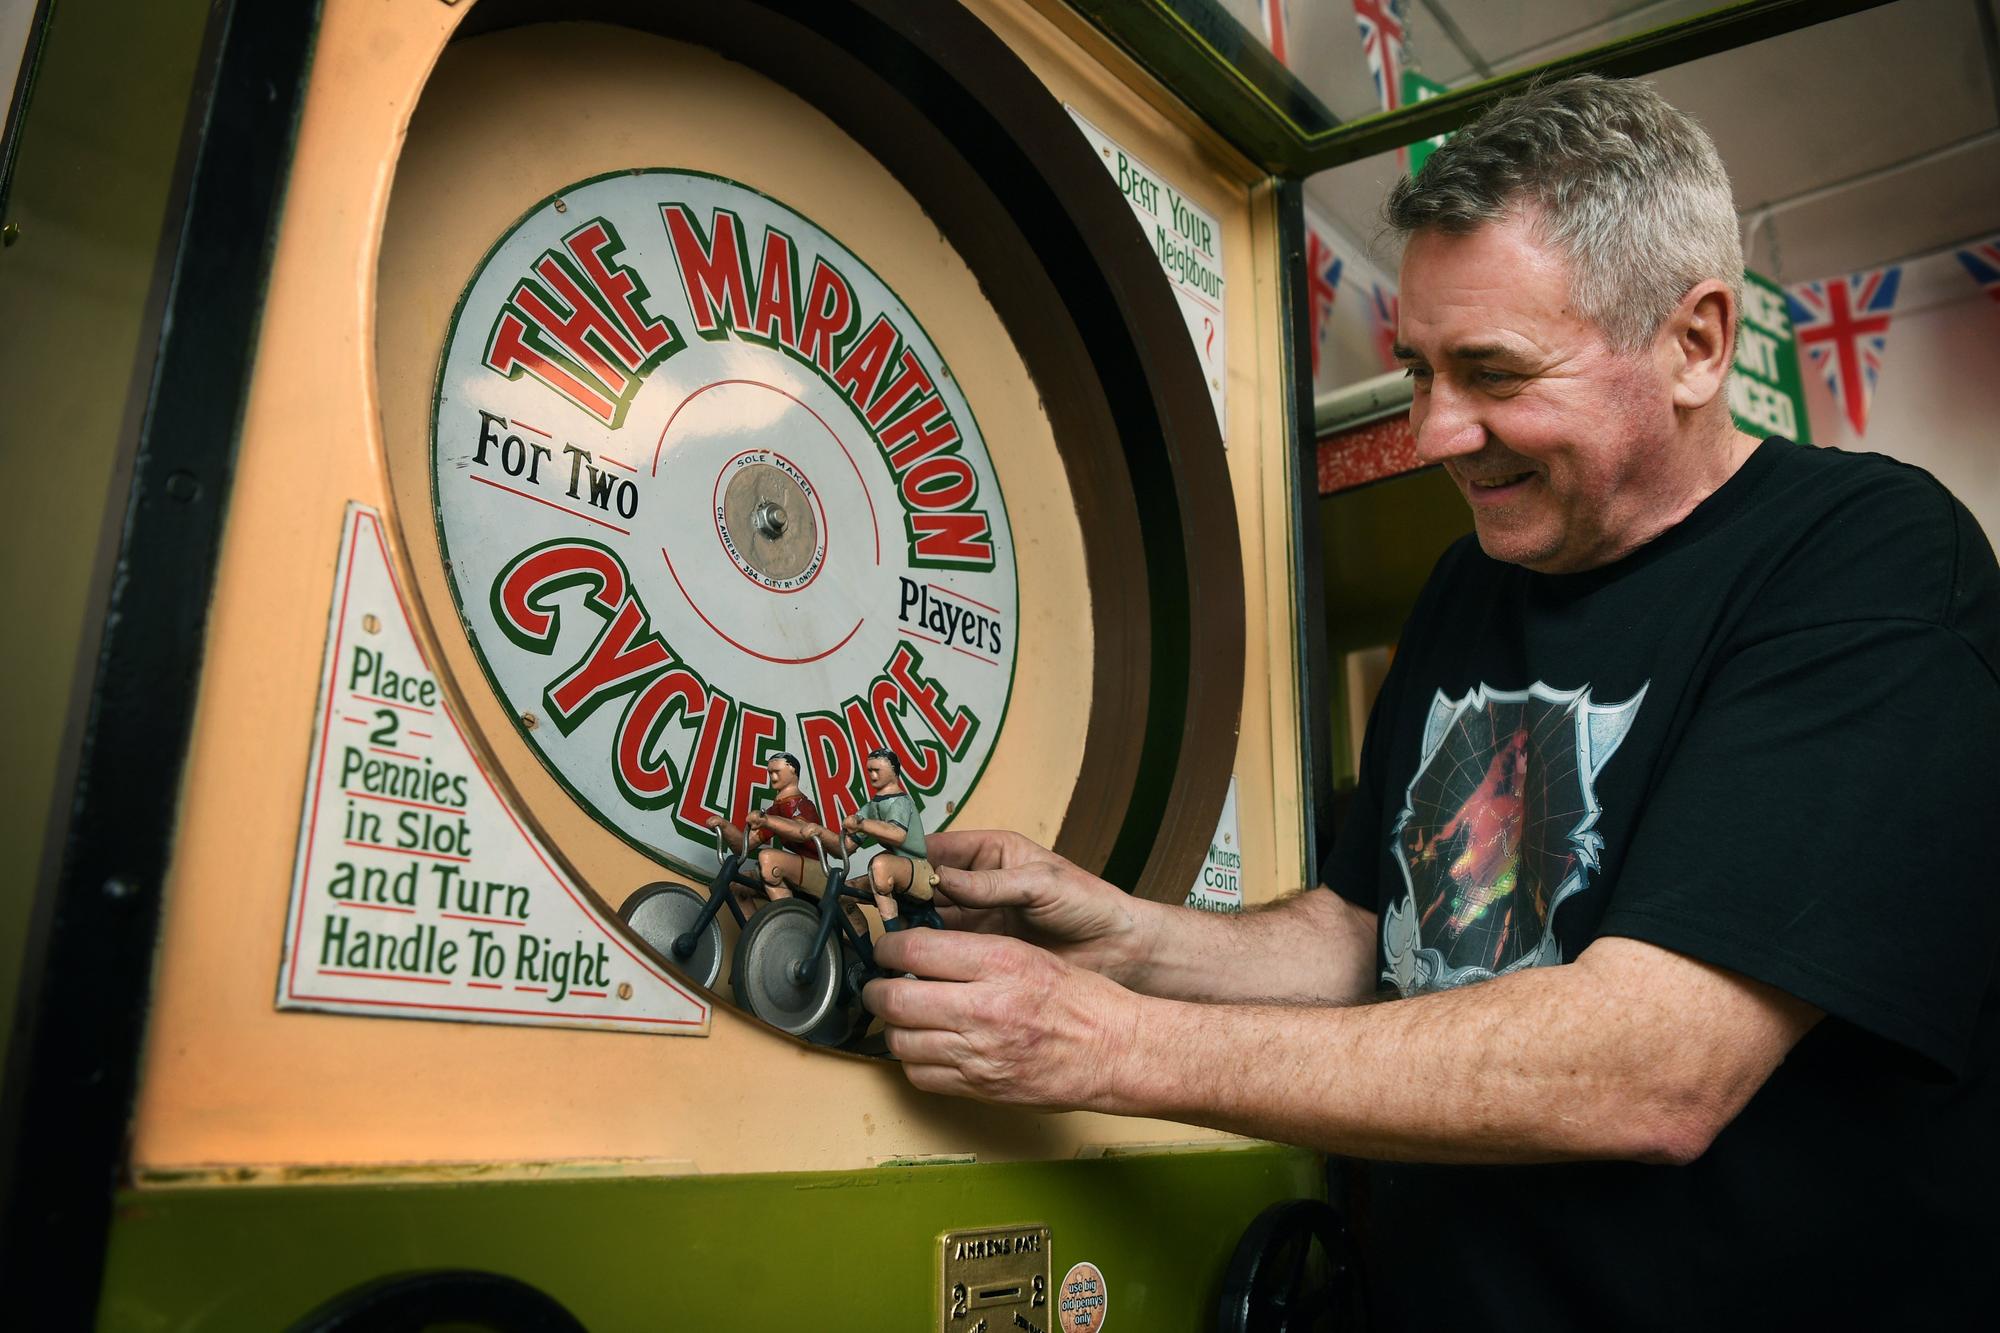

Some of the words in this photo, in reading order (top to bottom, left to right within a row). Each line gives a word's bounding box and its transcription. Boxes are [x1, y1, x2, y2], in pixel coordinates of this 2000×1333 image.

[1117, 152, 1160, 217] BEAT
[1166, 187, 1215, 258] YOUR
[1156, 224, 1224, 300] Neighbour
[482, 216, 687, 429] THE
[658, 202, 995, 573] MARATHON
[472, 409, 552, 485] For
[562, 442, 639, 520] Two
[738, 455, 766, 468] SOLE
[775, 459, 812, 496] MAKER
[764, 578, 782, 588] CITY
[795, 563, 818, 586] LONDON
[900, 576, 1001, 654] Players
[348, 645, 437, 707] Place
[490, 537, 786, 852] CYCLE
[369, 708, 399, 747] 2
[340, 747, 468, 807] Pennies
[343, 800, 382, 843] in
[396, 811, 472, 858] Slot
[1208, 844, 1240, 869] Winners
[327, 861, 420, 906] and
[431, 863, 531, 920] Turn
[1204, 867, 1238, 891] Coin
[319, 915, 458, 976] Handle
[468, 929, 506, 979] To
[514, 934, 611, 1002] Right
[1030, 1274, 1045, 1309] 2
[1062, 1297, 1075, 1311] old
[1076, 1295, 1103, 1311] pennys
[1069, 1282, 1083, 1293] use
[1084, 1278, 1097, 1293] big
[1075, 1311, 1091, 1326] only
